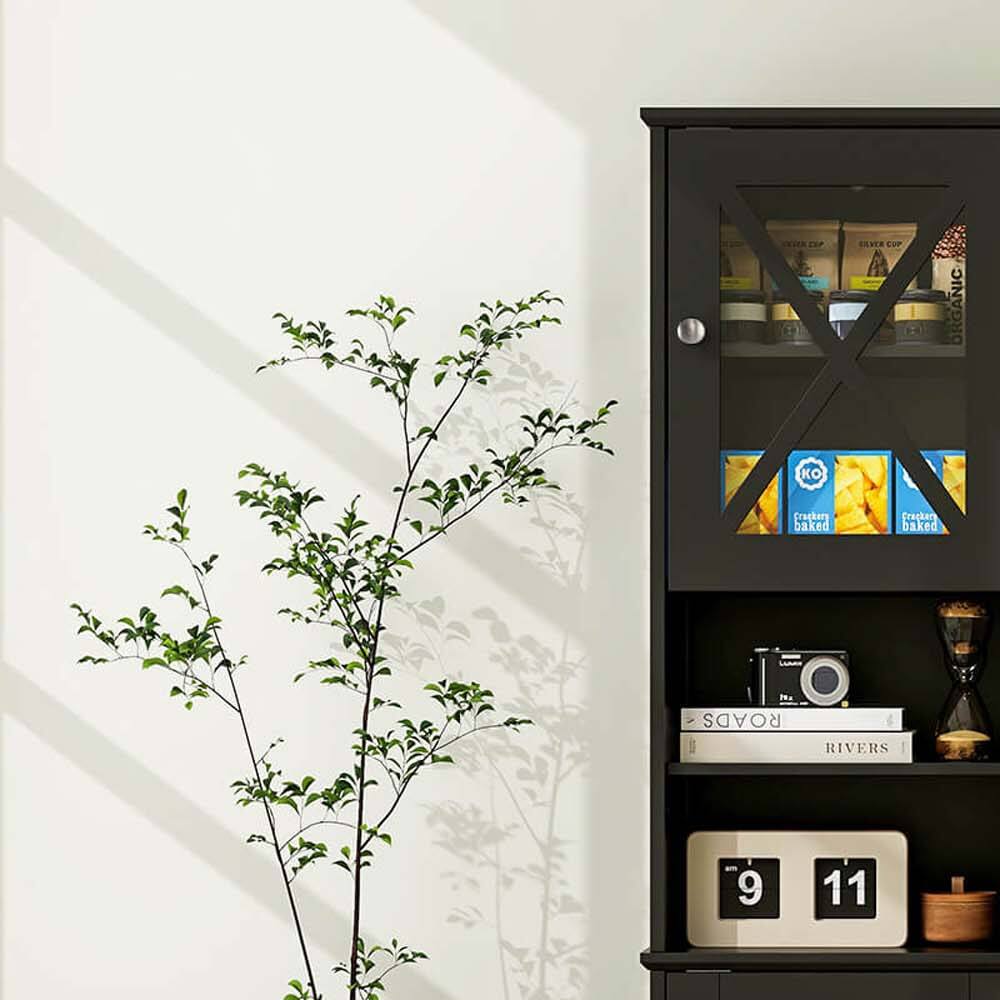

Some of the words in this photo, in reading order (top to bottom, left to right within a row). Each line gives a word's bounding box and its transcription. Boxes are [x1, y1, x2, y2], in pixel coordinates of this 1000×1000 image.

[951, 268, 963, 345] ORGANIC
[801, 468, 822, 480] KO
[794, 512, 830, 520] Crackers
[794, 518, 830, 531] baked
[902, 518, 937, 531] baked
[703, 713, 781, 728] ROADS
[826, 742, 889, 754] RIVERS
[738, 870, 763, 906] 9
[823, 870, 866, 905] 11
